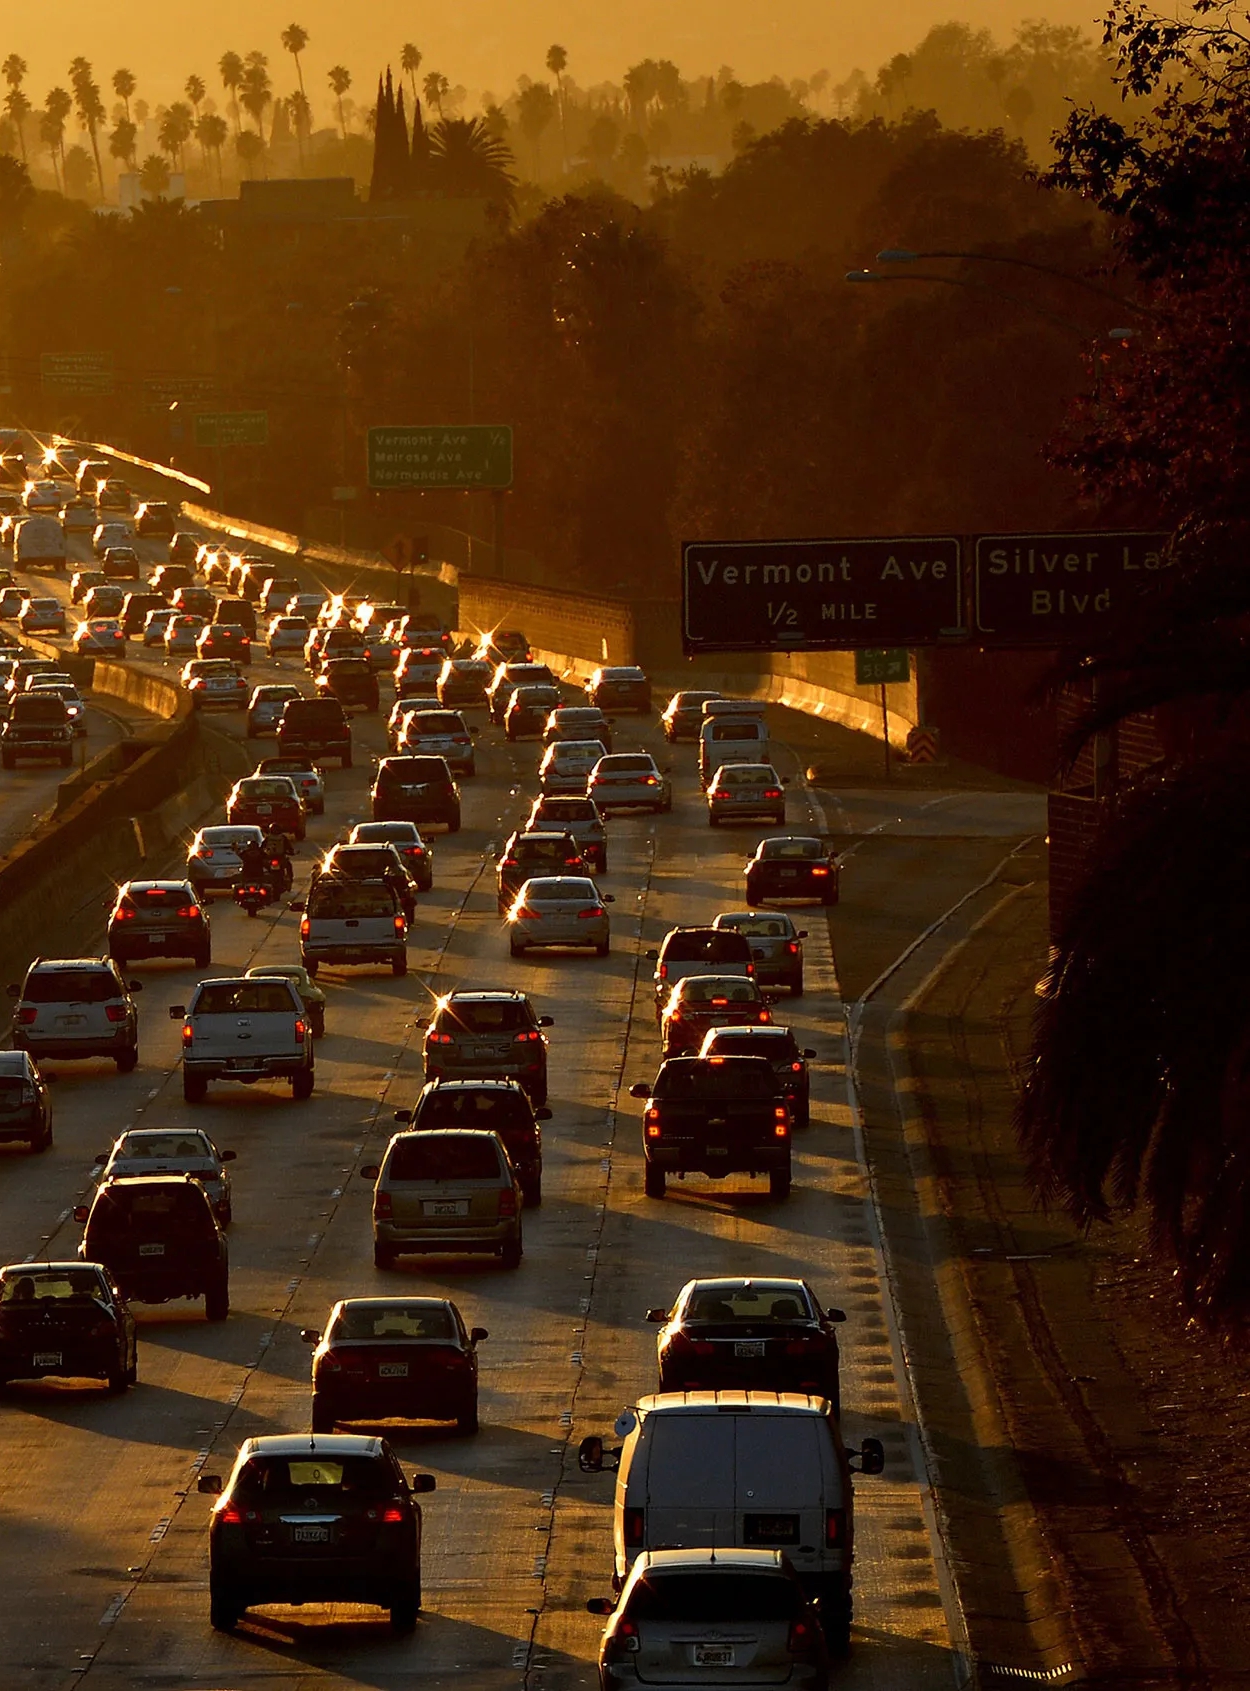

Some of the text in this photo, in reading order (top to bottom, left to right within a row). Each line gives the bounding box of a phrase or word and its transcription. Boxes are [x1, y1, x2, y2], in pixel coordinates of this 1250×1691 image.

[375, 434, 433, 445] Vermont
[441, 433, 469, 445] Ave
[374, 451, 463, 463] Melrose Ave
[456, 468, 483, 480] Ave
[696, 555, 949, 585] Vermont Ave
[988, 547, 1100, 575] Silver
[767, 601, 878, 625] 1/2 MILE
[1031, 587, 1111, 615] Blvd
